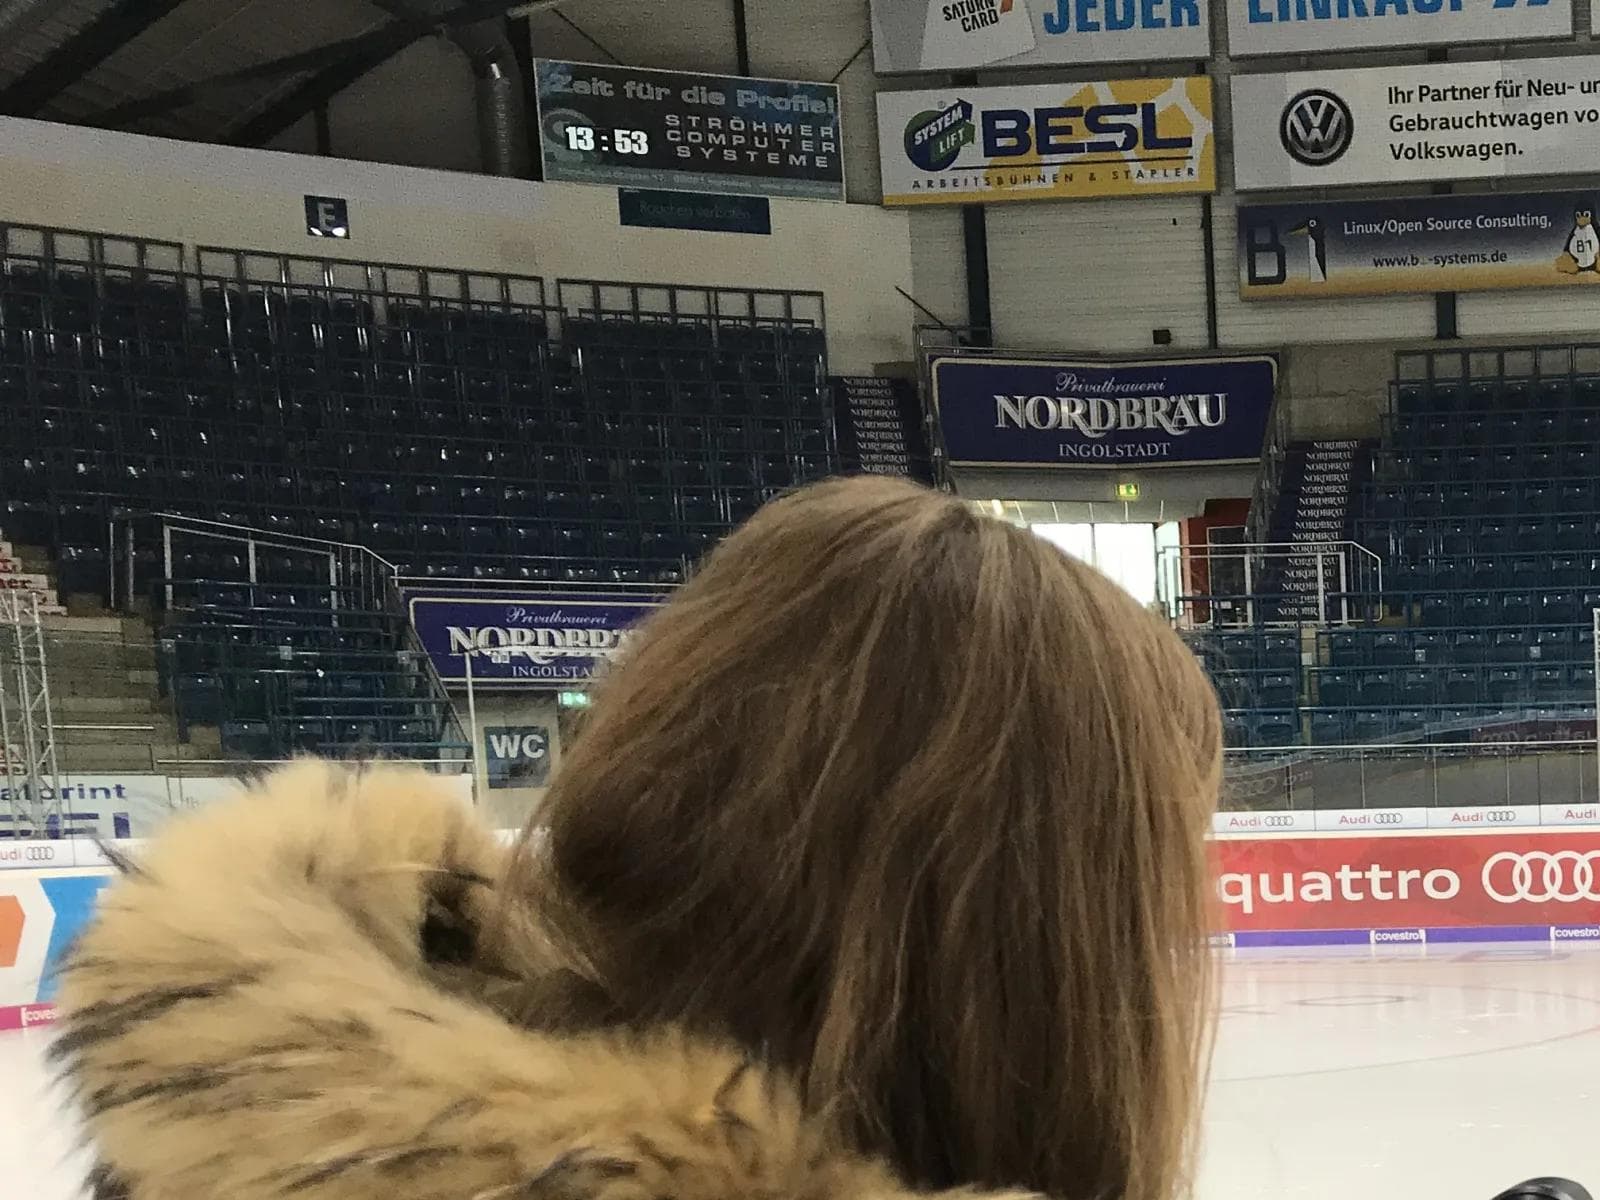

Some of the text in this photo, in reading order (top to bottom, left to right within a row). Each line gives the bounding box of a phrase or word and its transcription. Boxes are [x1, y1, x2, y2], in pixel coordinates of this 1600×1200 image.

[961, 8, 999, 32] CARD
[1043, 0, 1199, 35] JEDER
[550, 73, 615, 97] Zeit
[624, 79, 671, 101] für
[681, 87, 726, 106] die
[1388, 85, 1413, 105] Ihr
[1418, 83, 1491, 103] Partner
[1494, 80, 1523, 98] für
[1527, 79, 1575, 97] Neu-
[665, 113, 835, 138] STRÖHMER
[914, 105, 964, 146] SYSTEM
[981, 103, 1192, 158] BESL
[1389, 108, 1569, 133] Gebrauchtwagen
[565, 126, 649, 155] 13:53
[667, 130, 836, 153] COMPUTER
[938, 128, 966, 154] LIFT
[1389, 141, 1524, 161] Volkswagen.
[677, 145, 828, 168] SYSTEME
[1088, 173, 1098, 182] &
[1112, 168, 1196, 181] STAPLER
[318, 203, 336, 232] E
[1343, 213, 1552, 236] Linux/Open Source Consulting,
[1055, 372, 1167, 393] Privatbrauerei
[993, 393, 1228, 438] NORDBRÄU
[1059, 443, 1170, 458] INGOLSTADT
[506, 607, 608, 625] Privatbrauerei
[446, 626, 618, 664] NORDBR
[513, 665, 590, 679] INGOLSTA
[490, 734, 544, 759] WC
[1230, 817, 1261, 828] Audi
[1339, 815, 1371, 825] Audi
[1452, 811, 1484, 823] Audi
[1565, 808, 1597, 820] Audi
[1218, 864, 1461, 914] quattro
[1375, 930, 1422, 942] covestro
[1555, 927, 1600, 938] covestro
[26, 1007, 57, 1022] coves
